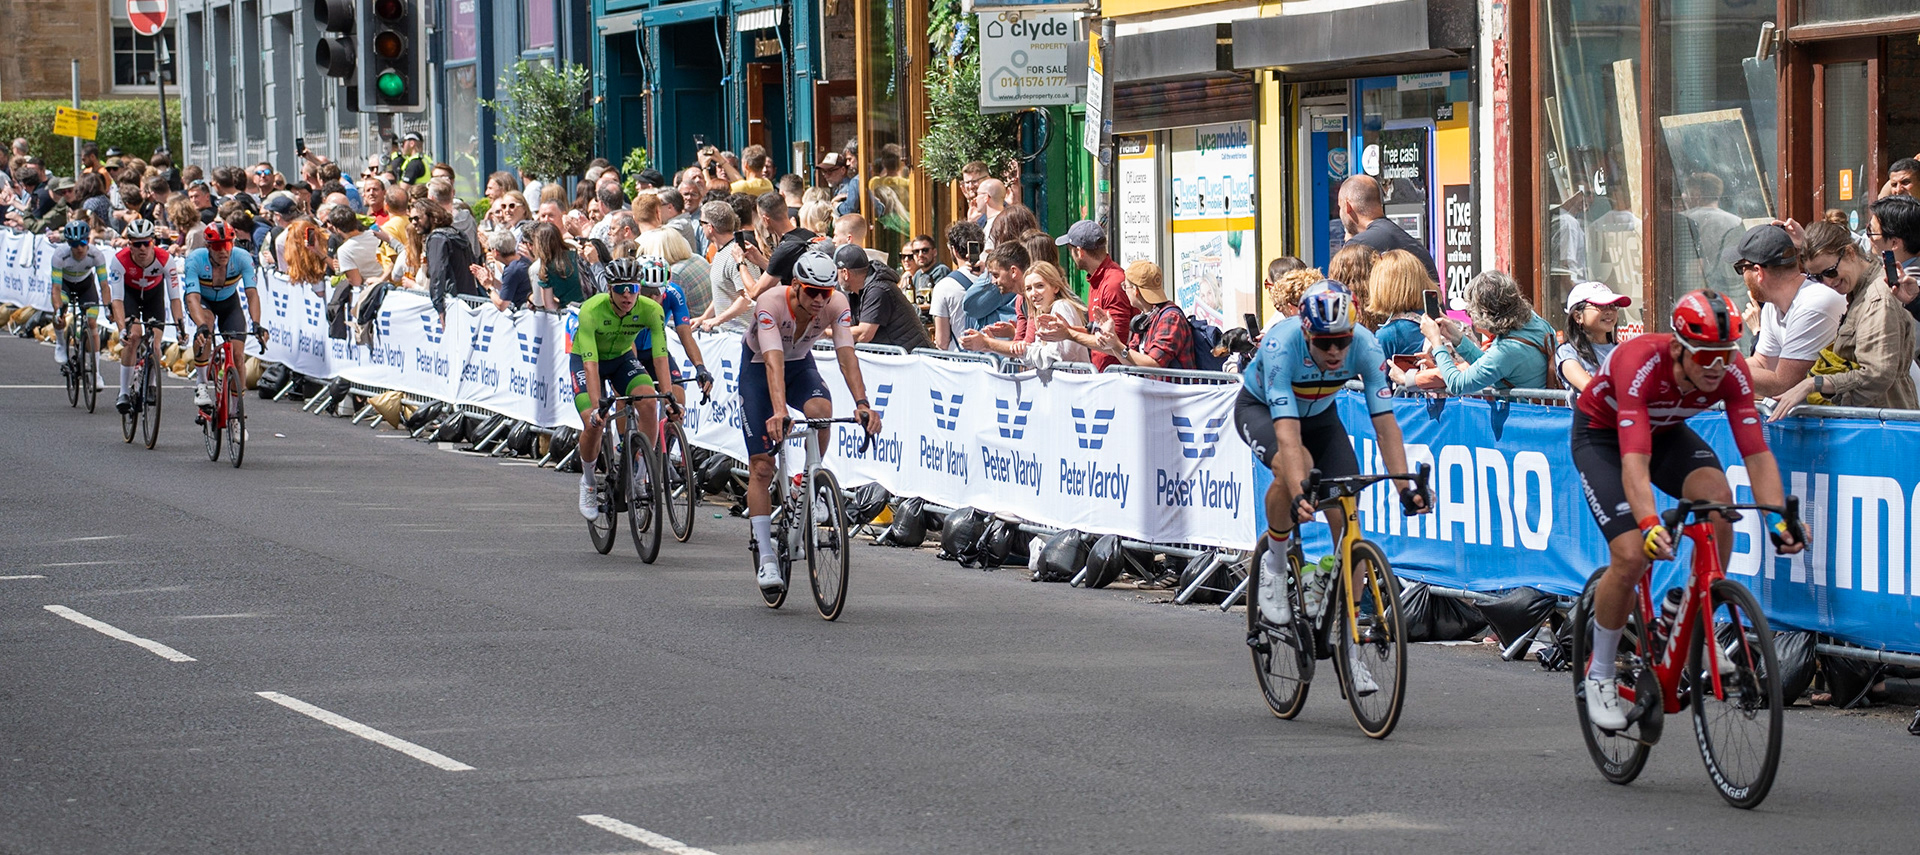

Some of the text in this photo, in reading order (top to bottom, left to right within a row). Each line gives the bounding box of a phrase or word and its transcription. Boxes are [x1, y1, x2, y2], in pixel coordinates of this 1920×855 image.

[1011, 17, 1067, 40] clyde
[1026, 66, 1068, 74] FOR SALE
[1196, 126, 1247, 156] Lycamobile
[1384, 142, 1419, 163] free cash
[1384, 163, 1419, 179] withdrawals
[1446, 228, 1458, 246] UK
[269, 320, 292, 352] Peter Vardy
[300, 330, 326, 362] Peter Vardy
[385, 344, 405, 373] Vardy
[416, 348, 432, 376] Peter
[1628, 352, 1662, 398] postnord
[480, 360, 500, 393] Vardy
[510, 368, 528, 396] Peter
[529, 372, 548, 408] Vardy
[558, 377, 574, 404] Pete
[1726, 362, 1752, 396] stnord
[682, 401, 700, 435] ardy
[920, 435, 968, 485] Peter Vardy
[981, 446, 1042, 496] Peter Vardy
[793, 469, 809, 530] CANYON
[1060, 458, 1129, 509] Peter Vardy
[1157, 468, 1241, 519] Peter Vardy
[1345, 434, 1553, 551] HIMANO
[1725, 464, 1920, 597] SHIM
[1694, 713, 1750, 799] BONTRAGER
